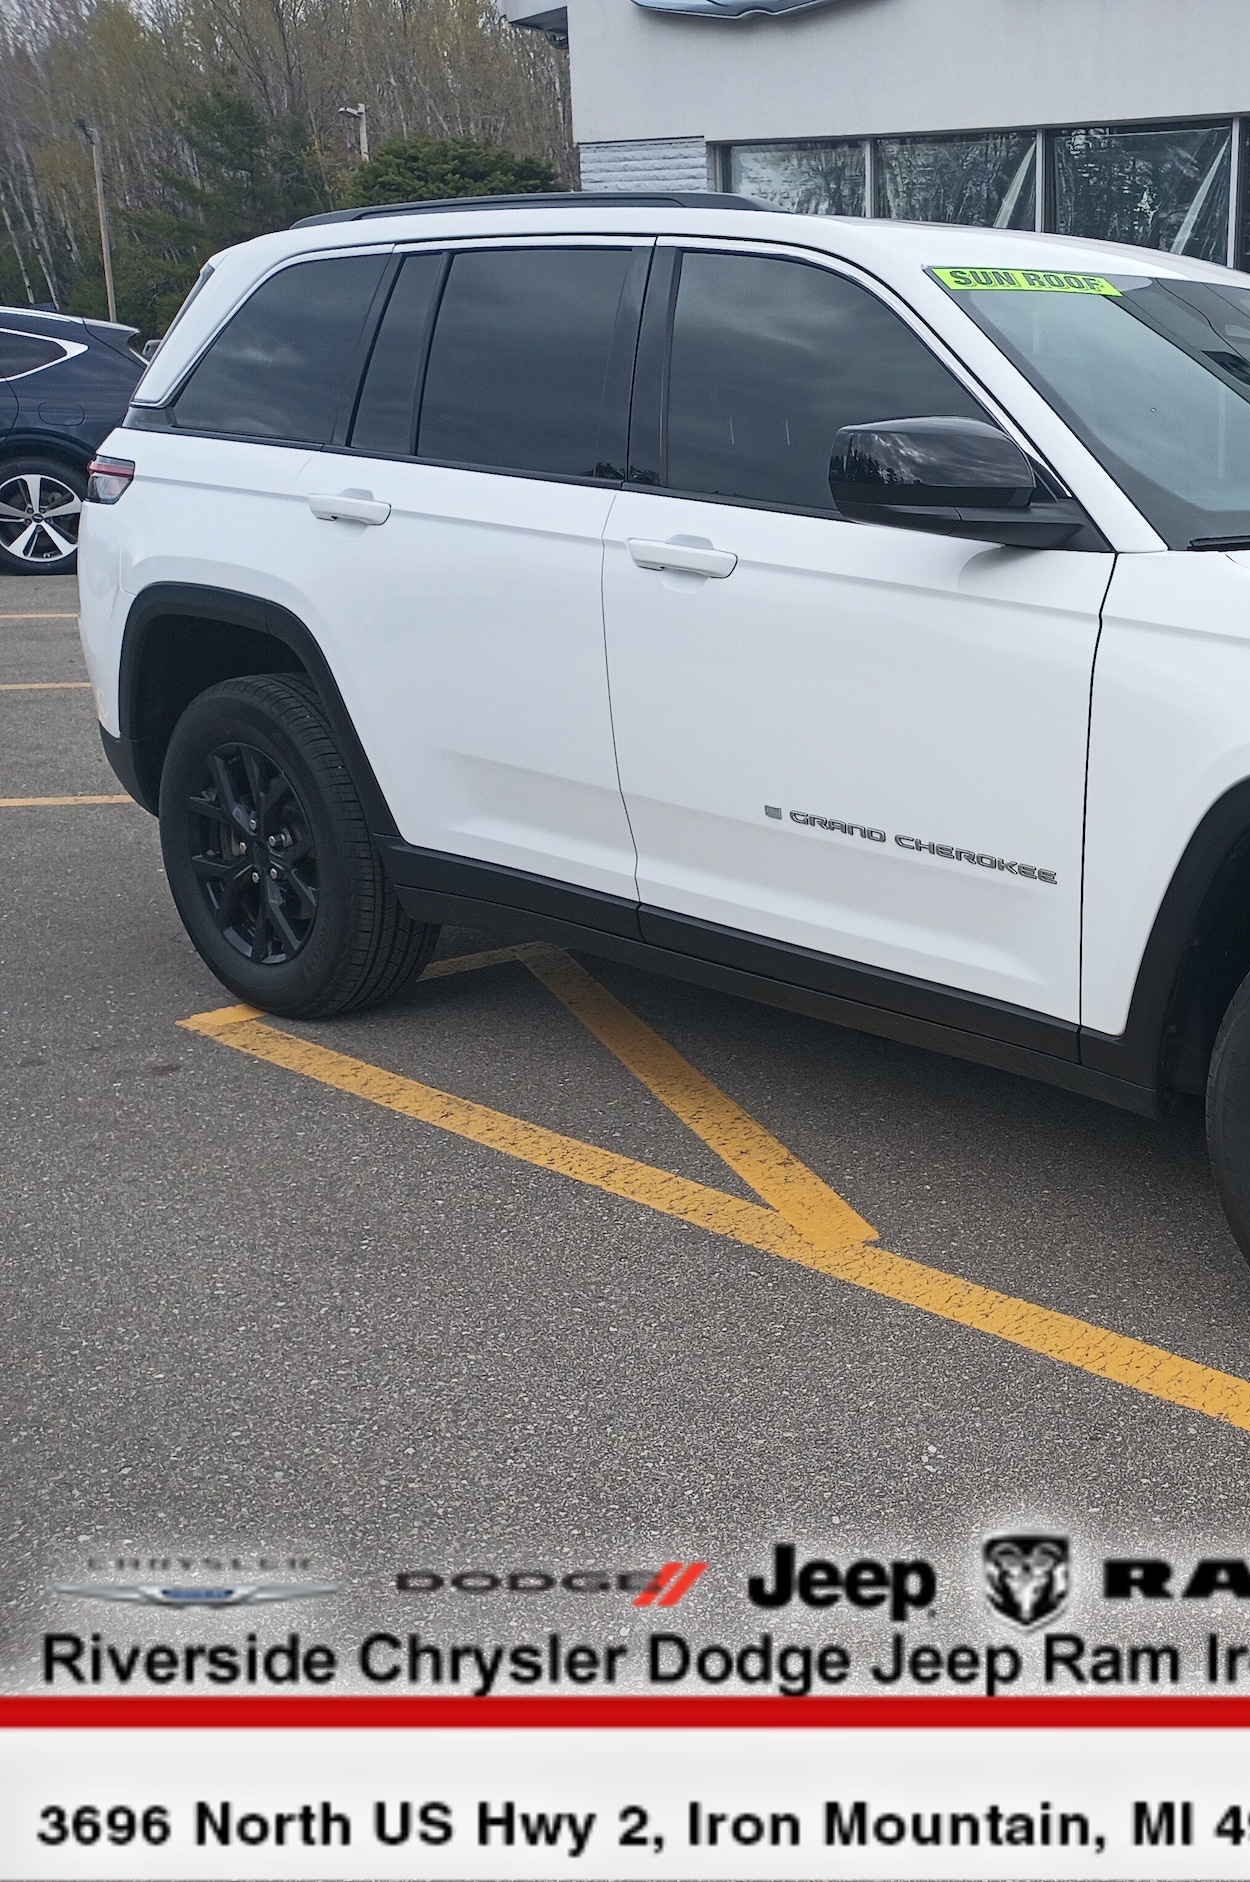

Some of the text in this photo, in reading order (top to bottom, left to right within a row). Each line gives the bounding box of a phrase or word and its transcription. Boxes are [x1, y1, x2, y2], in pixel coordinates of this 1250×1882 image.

[949, 270, 1104, 291] SUN ROOF
[789, 809, 1058, 885] GRAND CHEROKEE
